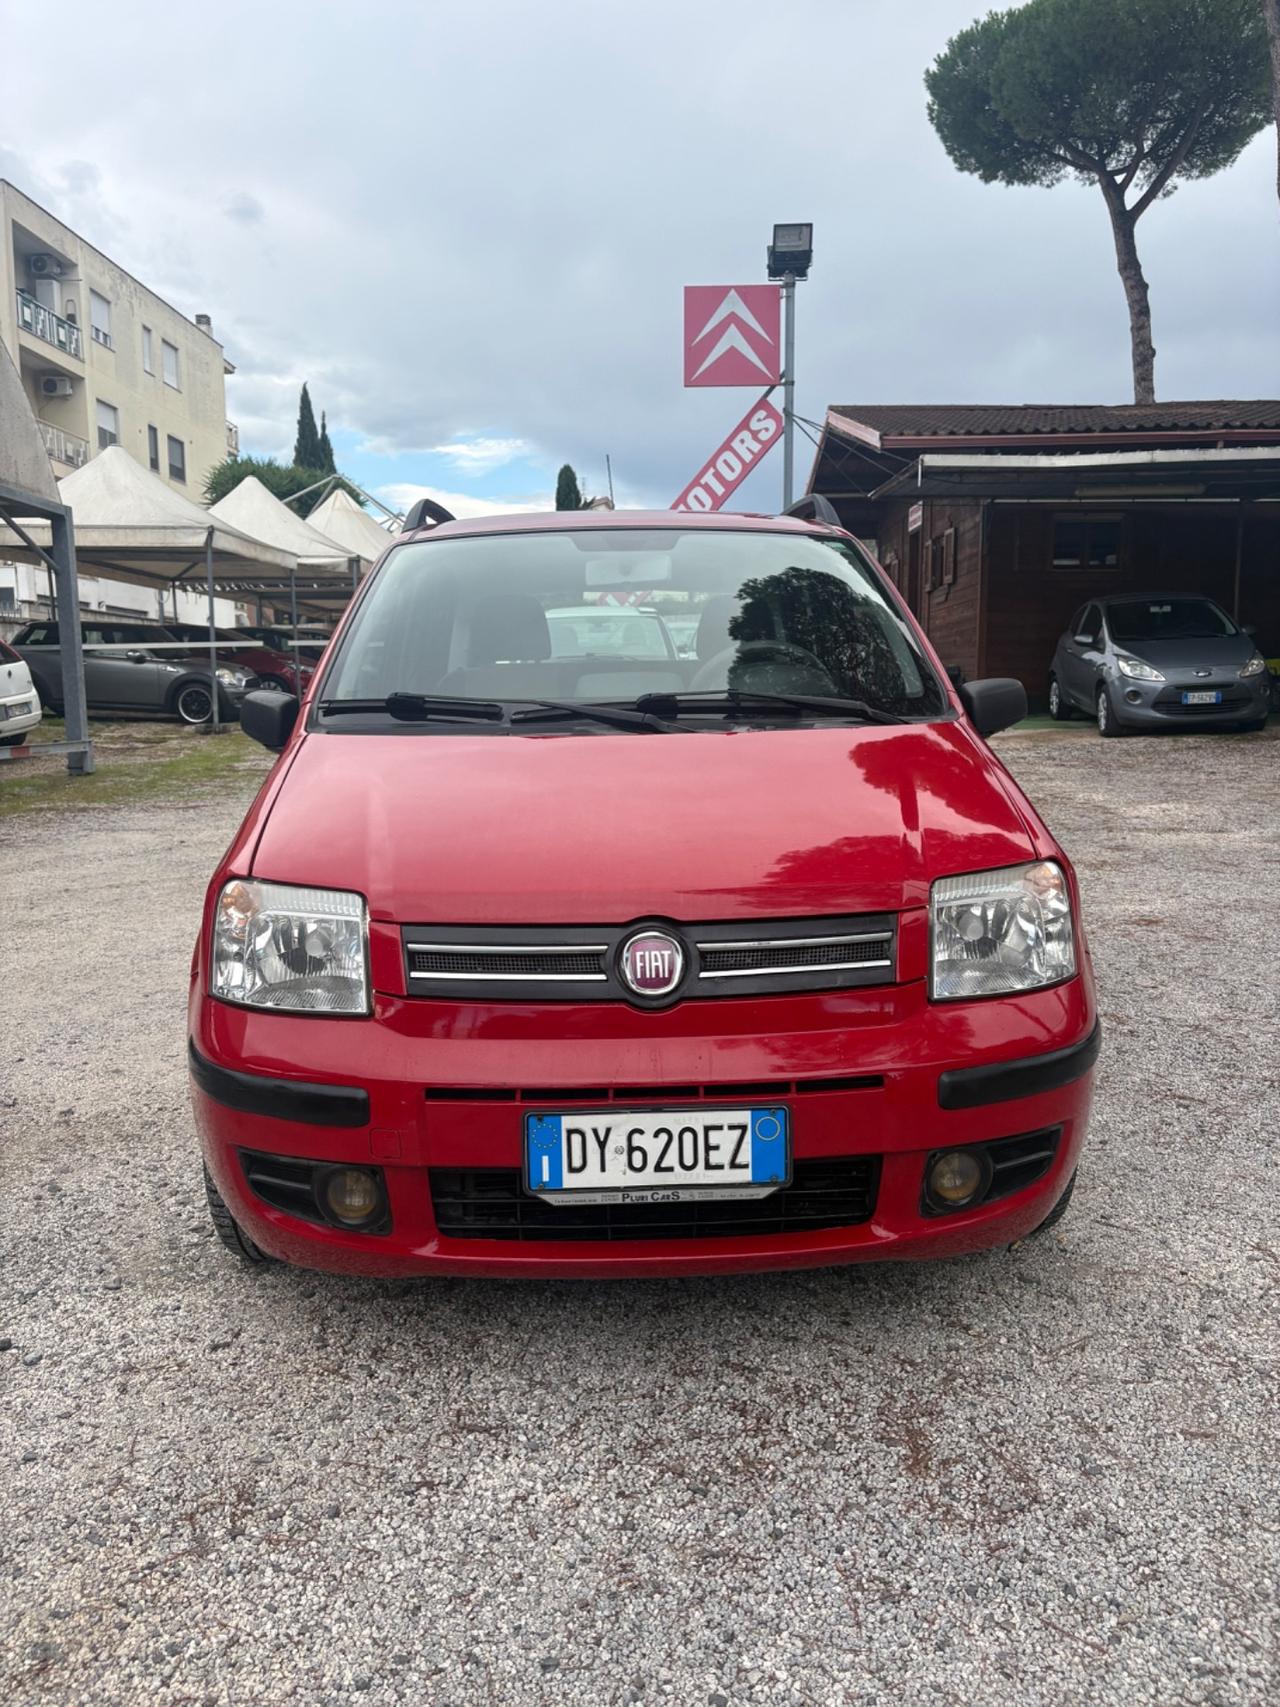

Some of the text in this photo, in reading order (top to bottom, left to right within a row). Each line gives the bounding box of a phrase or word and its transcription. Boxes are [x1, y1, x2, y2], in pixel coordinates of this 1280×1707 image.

[678, 409, 777, 511] OTORS
[635, 951, 672, 979] FIAT
[565, 1124, 749, 1174] DY 620EZ
